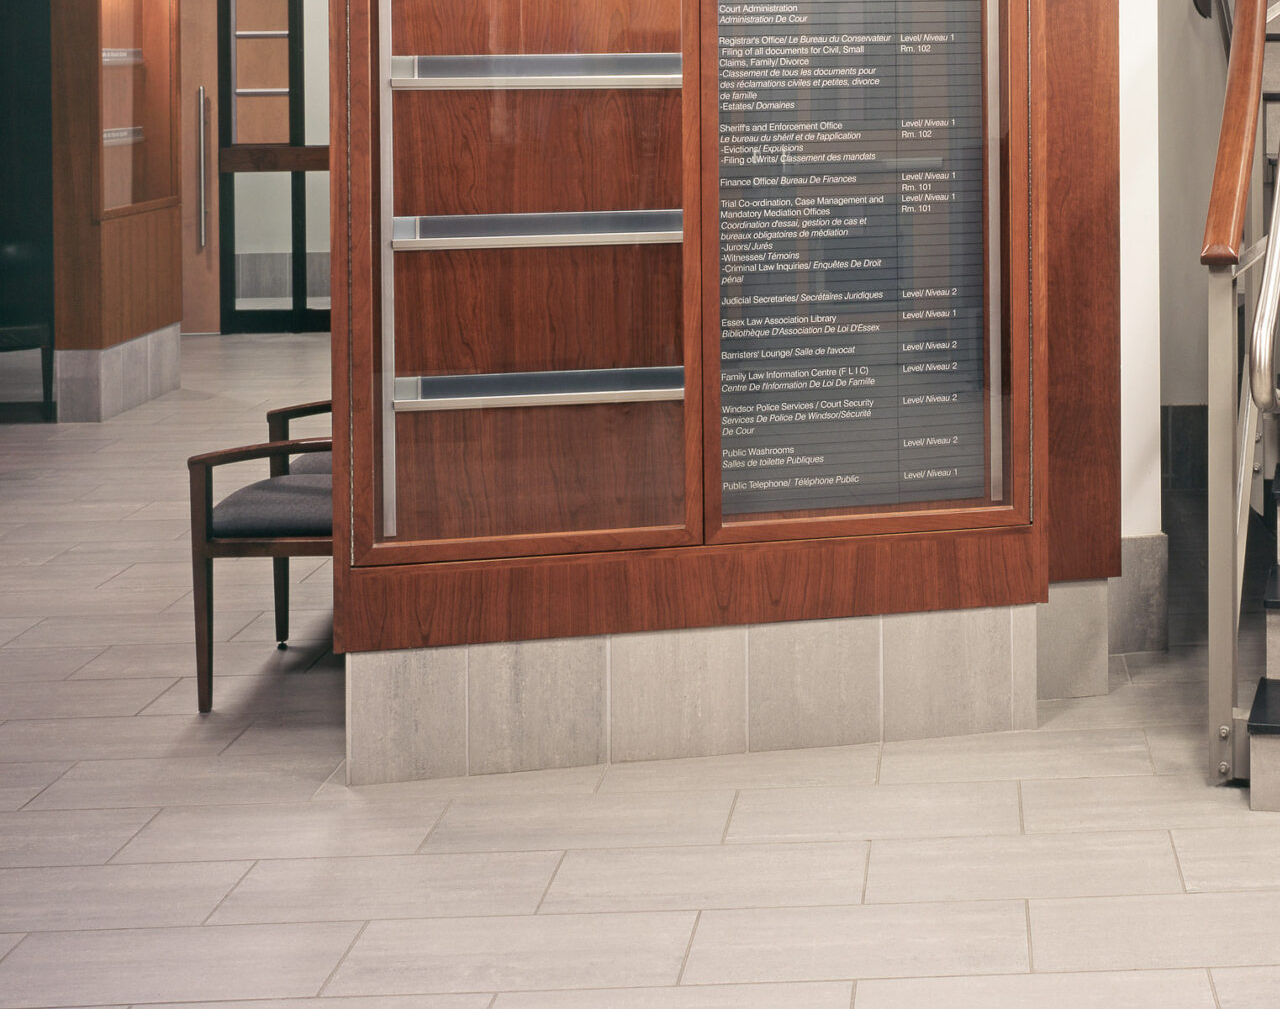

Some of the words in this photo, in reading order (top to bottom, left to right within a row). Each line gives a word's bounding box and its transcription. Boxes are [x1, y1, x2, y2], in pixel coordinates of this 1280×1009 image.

[742, 4, 797, 12] Administration
[719, 15, 773, 23] Administration
[788, 14, 808, 22] Cour
[718, 37, 759, 46] Registrar's
[760, 36, 786, 44] Office/
[799, 35, 827, 43] Bureau
[841, 34, 891, 42] Conservateur
[923, 33, 948, 41] Niveau
[917, 44, 931, 52] 102
[719, 58, 748, 67] Claims,
[750, 58, 778, 67] Family/
[779, 57, 809, 65] Divorce
[719, 80, 734, 88] des
[736, 79, 785, 87] réclamations
[821, 78, 849, 87] petites,
[851, 77, 879, 85] divorce
[719, 102, 754, 110] -Estates/
[755, 101, 795, 109] Domaines
[719, 124, 750, 132] Sheriff's
[751, 123, 767, 131] and
[769, 122, 818, 131] Enforcement
[901, 119, 923, 127] Level/
[951, 118, 955, 126] 1
[901, 130, 916, 138] Rm.
[720, 178, 751, 186] Finance
[752, 177, 778, 185] Office/
[779, 176, 807, 184] Bureau
[809, 175, 820, 183] De
[822, 174, 856, 183] Finances
[901, 172, 923, 180] Level/
[901, 183, 916, 191] Rm.
[720, 200, 736, 208] Trial
[737, 198, 793, 208] Co-ordination,
[794, 197, 815, 205] Case
[816, 195, 867, 206] Management
[868, 195, 884, 203] and
[924, 193, 949, 201] Niveau
[720, 209, 761, 220] Mandatory
[763, 208, 801, 217] Mediation
[802, 207, 830, 215] Offices
[720, 231, 751, 240] bureaux
[753, 230, 797, 240] obligatoires
[799, 229, 809, 237] de
[810, 228, 848, 236] médiation
[902, 289, 924, 297] Level/
[925, 288, 950, 296] Niveau
[721, 296, 751, 305] Judicial
[752, 294, 798, 303] Secretaries/
[800, 292, 842, 301] Secrétaires
[844, 290, 883, 301] Juridiques
[925, 309, 950, 317] Niveau
[721, 318, 744, 326] Essex
[746, 317, 762, 325] Law
[763, 315, 808, 324] Association
[810, 314, 836, 324] Library
[902, 342, 924, 350] Level/
[925, 341, 950, 349] Niveau
[902, 364, 924, 372] Level/
[925, 362, 950, 371] Niveau
[902, 395, 924, 404] Level/
[925, 394, 950, 403] Niveau
[721, 404, 754, 413] Windsor
[756, 403, 779, 411] Police
[781, 401, 813, 410] Services
[820, 400, 841, 408] Court
[843, 398, 873, 408] Security
[902, 438, 924, 446] Level/
[925, 437, 951, 445] Niveau
[722, 448, 746, 457] Public
[748, 446, 794, 455] Washrooms
[903, 470, 925, 478] Level/
[926, 469, 951, 477] Niveau
[722, 481, 747, 490] Public
[748, 479, 791, 490] Telephone/
[793, 476, 833, 487] Téléphone
[835, 475, 859, 483] Public
